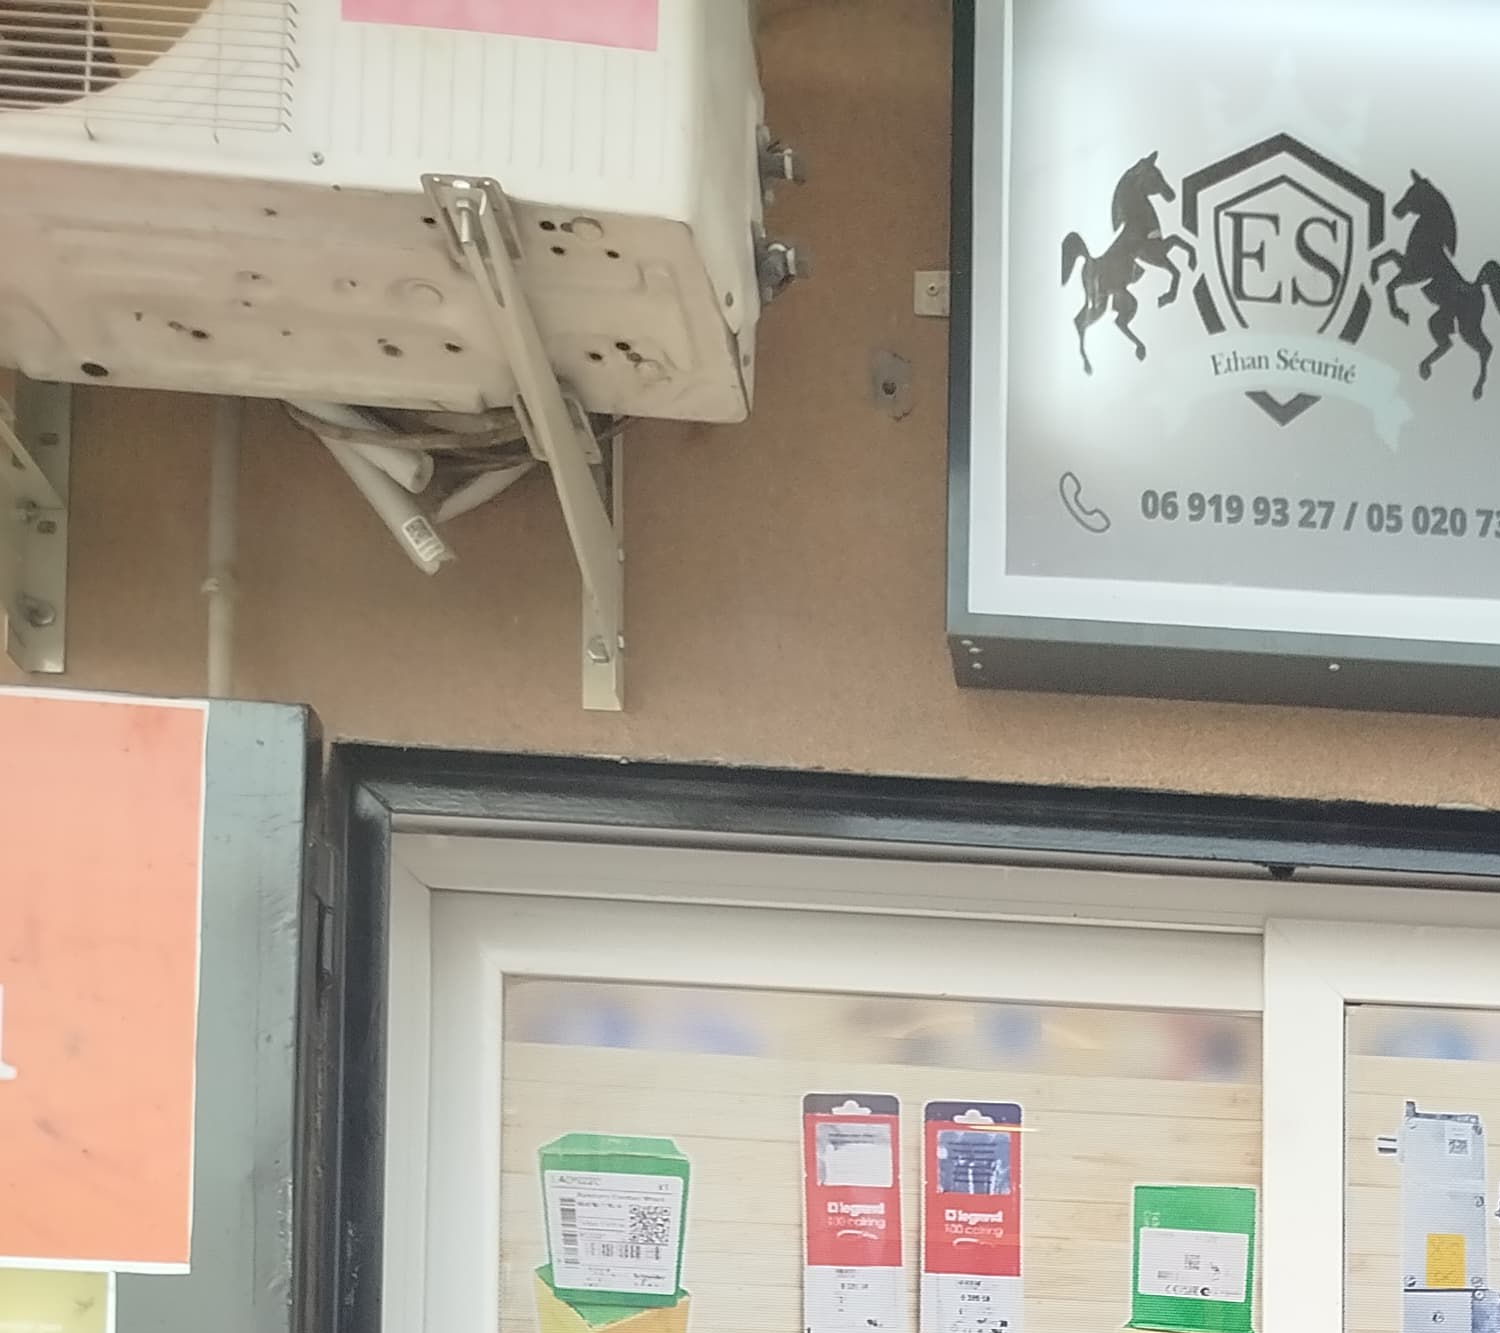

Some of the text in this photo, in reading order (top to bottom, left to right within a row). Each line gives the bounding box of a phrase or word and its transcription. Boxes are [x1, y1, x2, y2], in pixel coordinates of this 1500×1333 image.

[1227, 212, 1344, 310] ES
[1211, 348, 1357, 384] Ethan Sécurité
[1141, 490, 1182, 522] 06
[1188, 492, 1245, 525] 919
[1253, 495, 1292, 527] 93
[1299, 497, 1337, 529] 27
[1366, 501, 1403, 534] 05
[1403, 503, 1466, 536] 020
